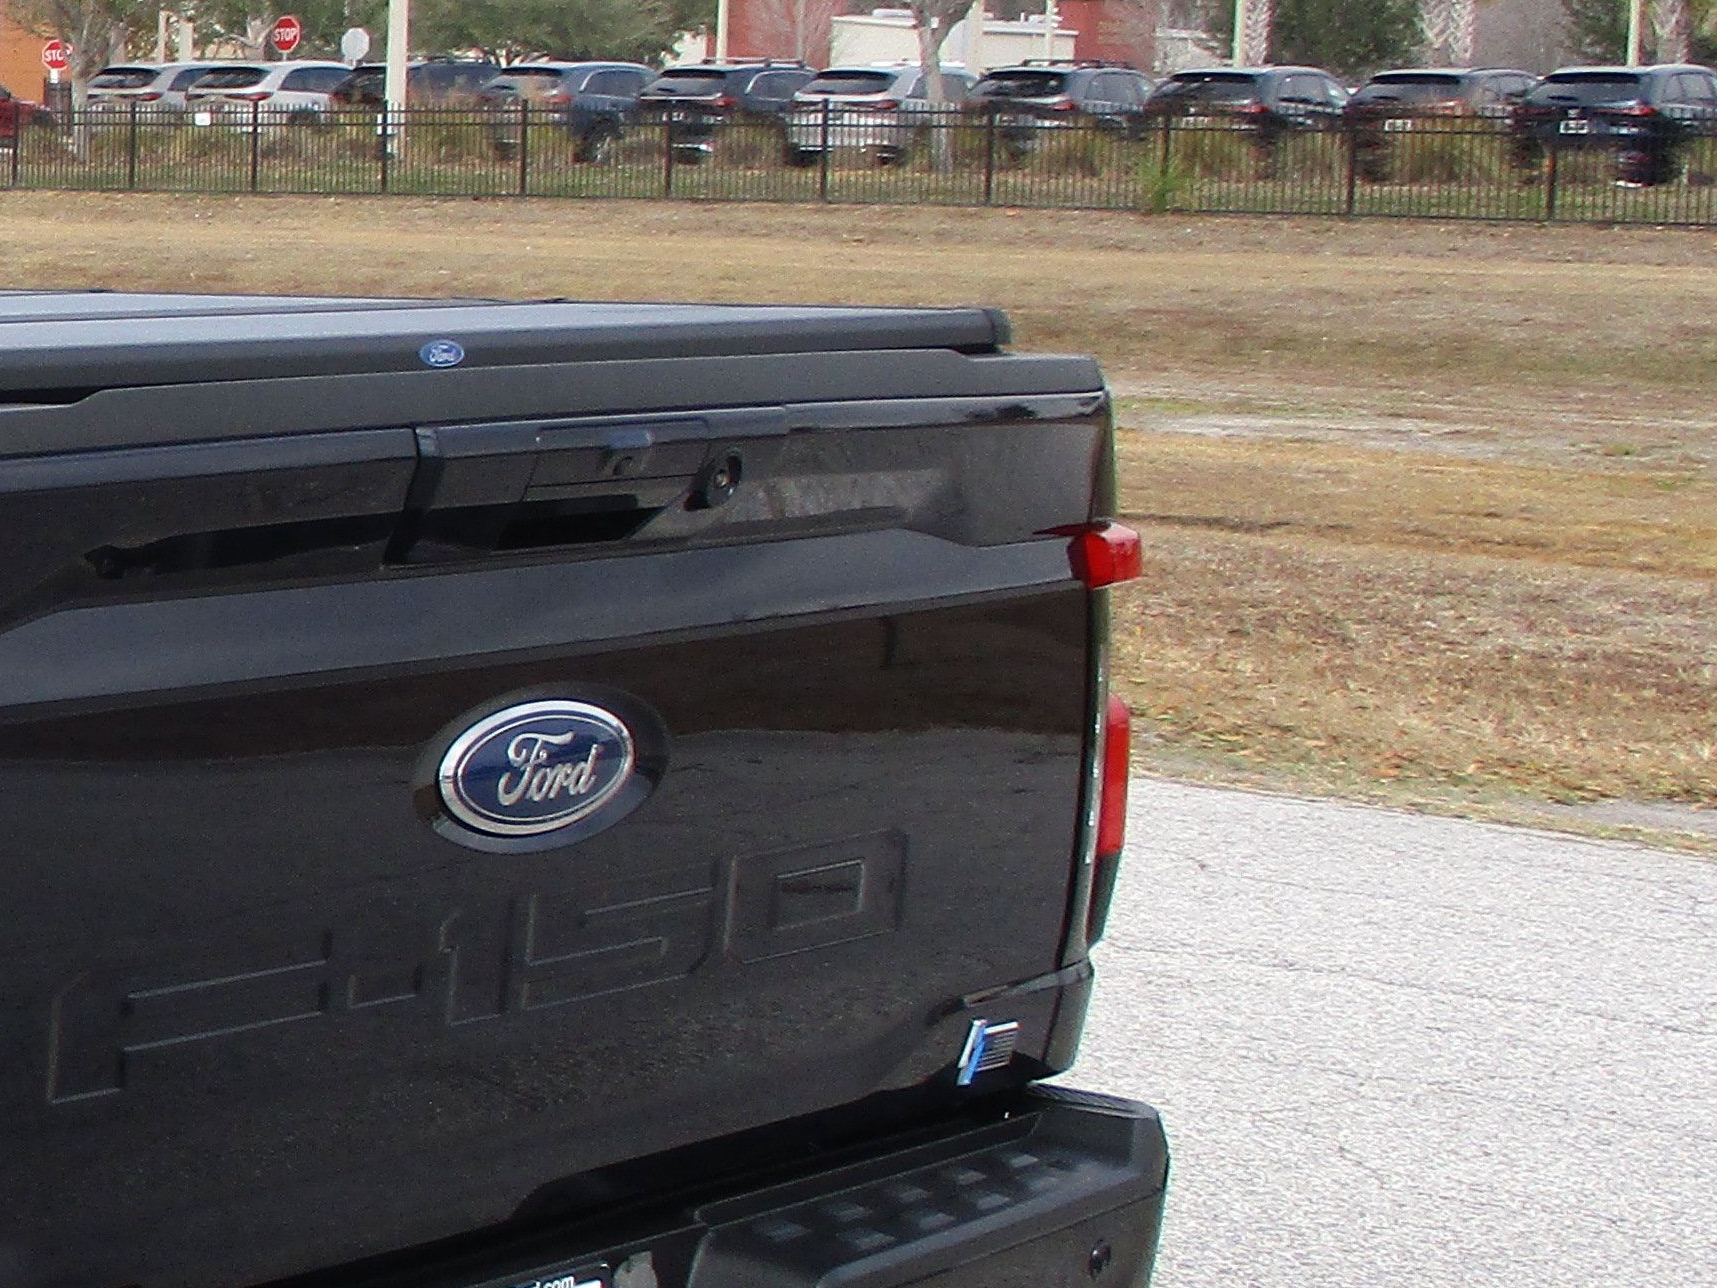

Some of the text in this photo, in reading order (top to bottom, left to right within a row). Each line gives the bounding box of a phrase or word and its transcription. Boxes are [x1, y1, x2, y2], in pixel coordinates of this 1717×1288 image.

[44, 49, 71, 62] STO
[274, 27, 296, 42] STOP
[497, 730, 598, 806] Ford
[49, 827, 907, 1105] F-150
